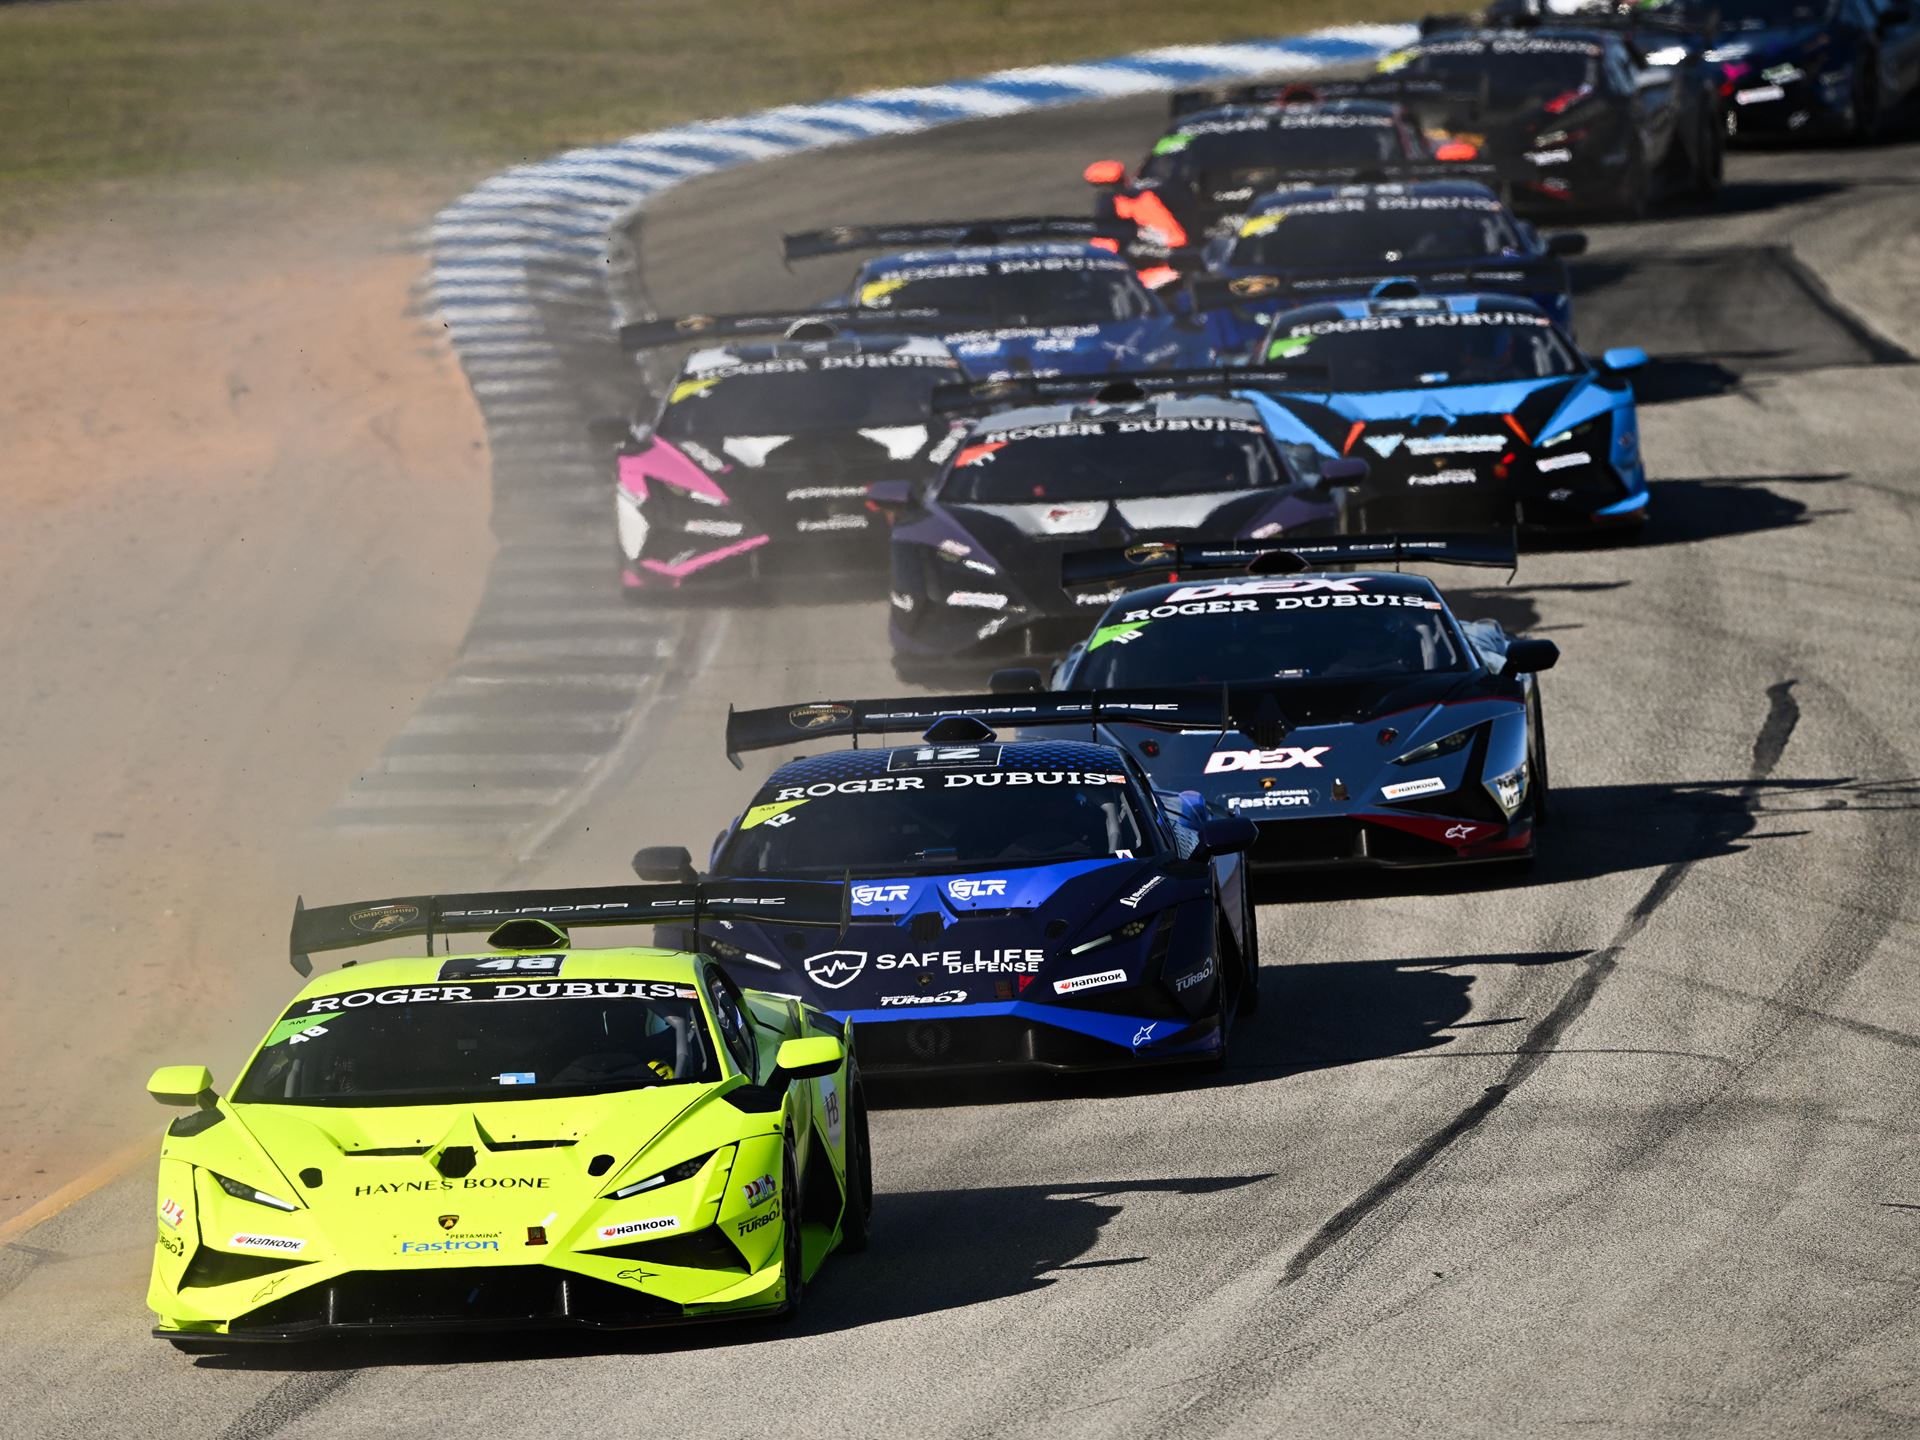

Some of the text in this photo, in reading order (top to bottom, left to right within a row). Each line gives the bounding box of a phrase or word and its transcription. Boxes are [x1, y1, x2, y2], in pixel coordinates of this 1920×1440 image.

[1122, 593, 1424, 622] ROGER DUBUIS
[914, 747, 980, 761] 12
[1204, 746, 1332, 773] DEX
[776, 772, 1107, 801] ROGER DUBUIS
[1228, 796, 1309, 809] Fastron
[852, 885, 910, 904] SLR
[950, 879, 1007, 899] SLR
[442, 897, 786, 917] SQUADRA CORSE
[476, 957, 557, 971] 48
[875, 949, 1044, 969] SAFE LIFE
[949, 961, 1039, 974] DEFENSE
[306, 982, 675, 1013] ROGER DUBUIS
[355, 1177, 551, 1196] HAYNES BOONE
[738, 1211, 777, 1237] TURBO
[401, 1240, 499, 1253] Fastron
